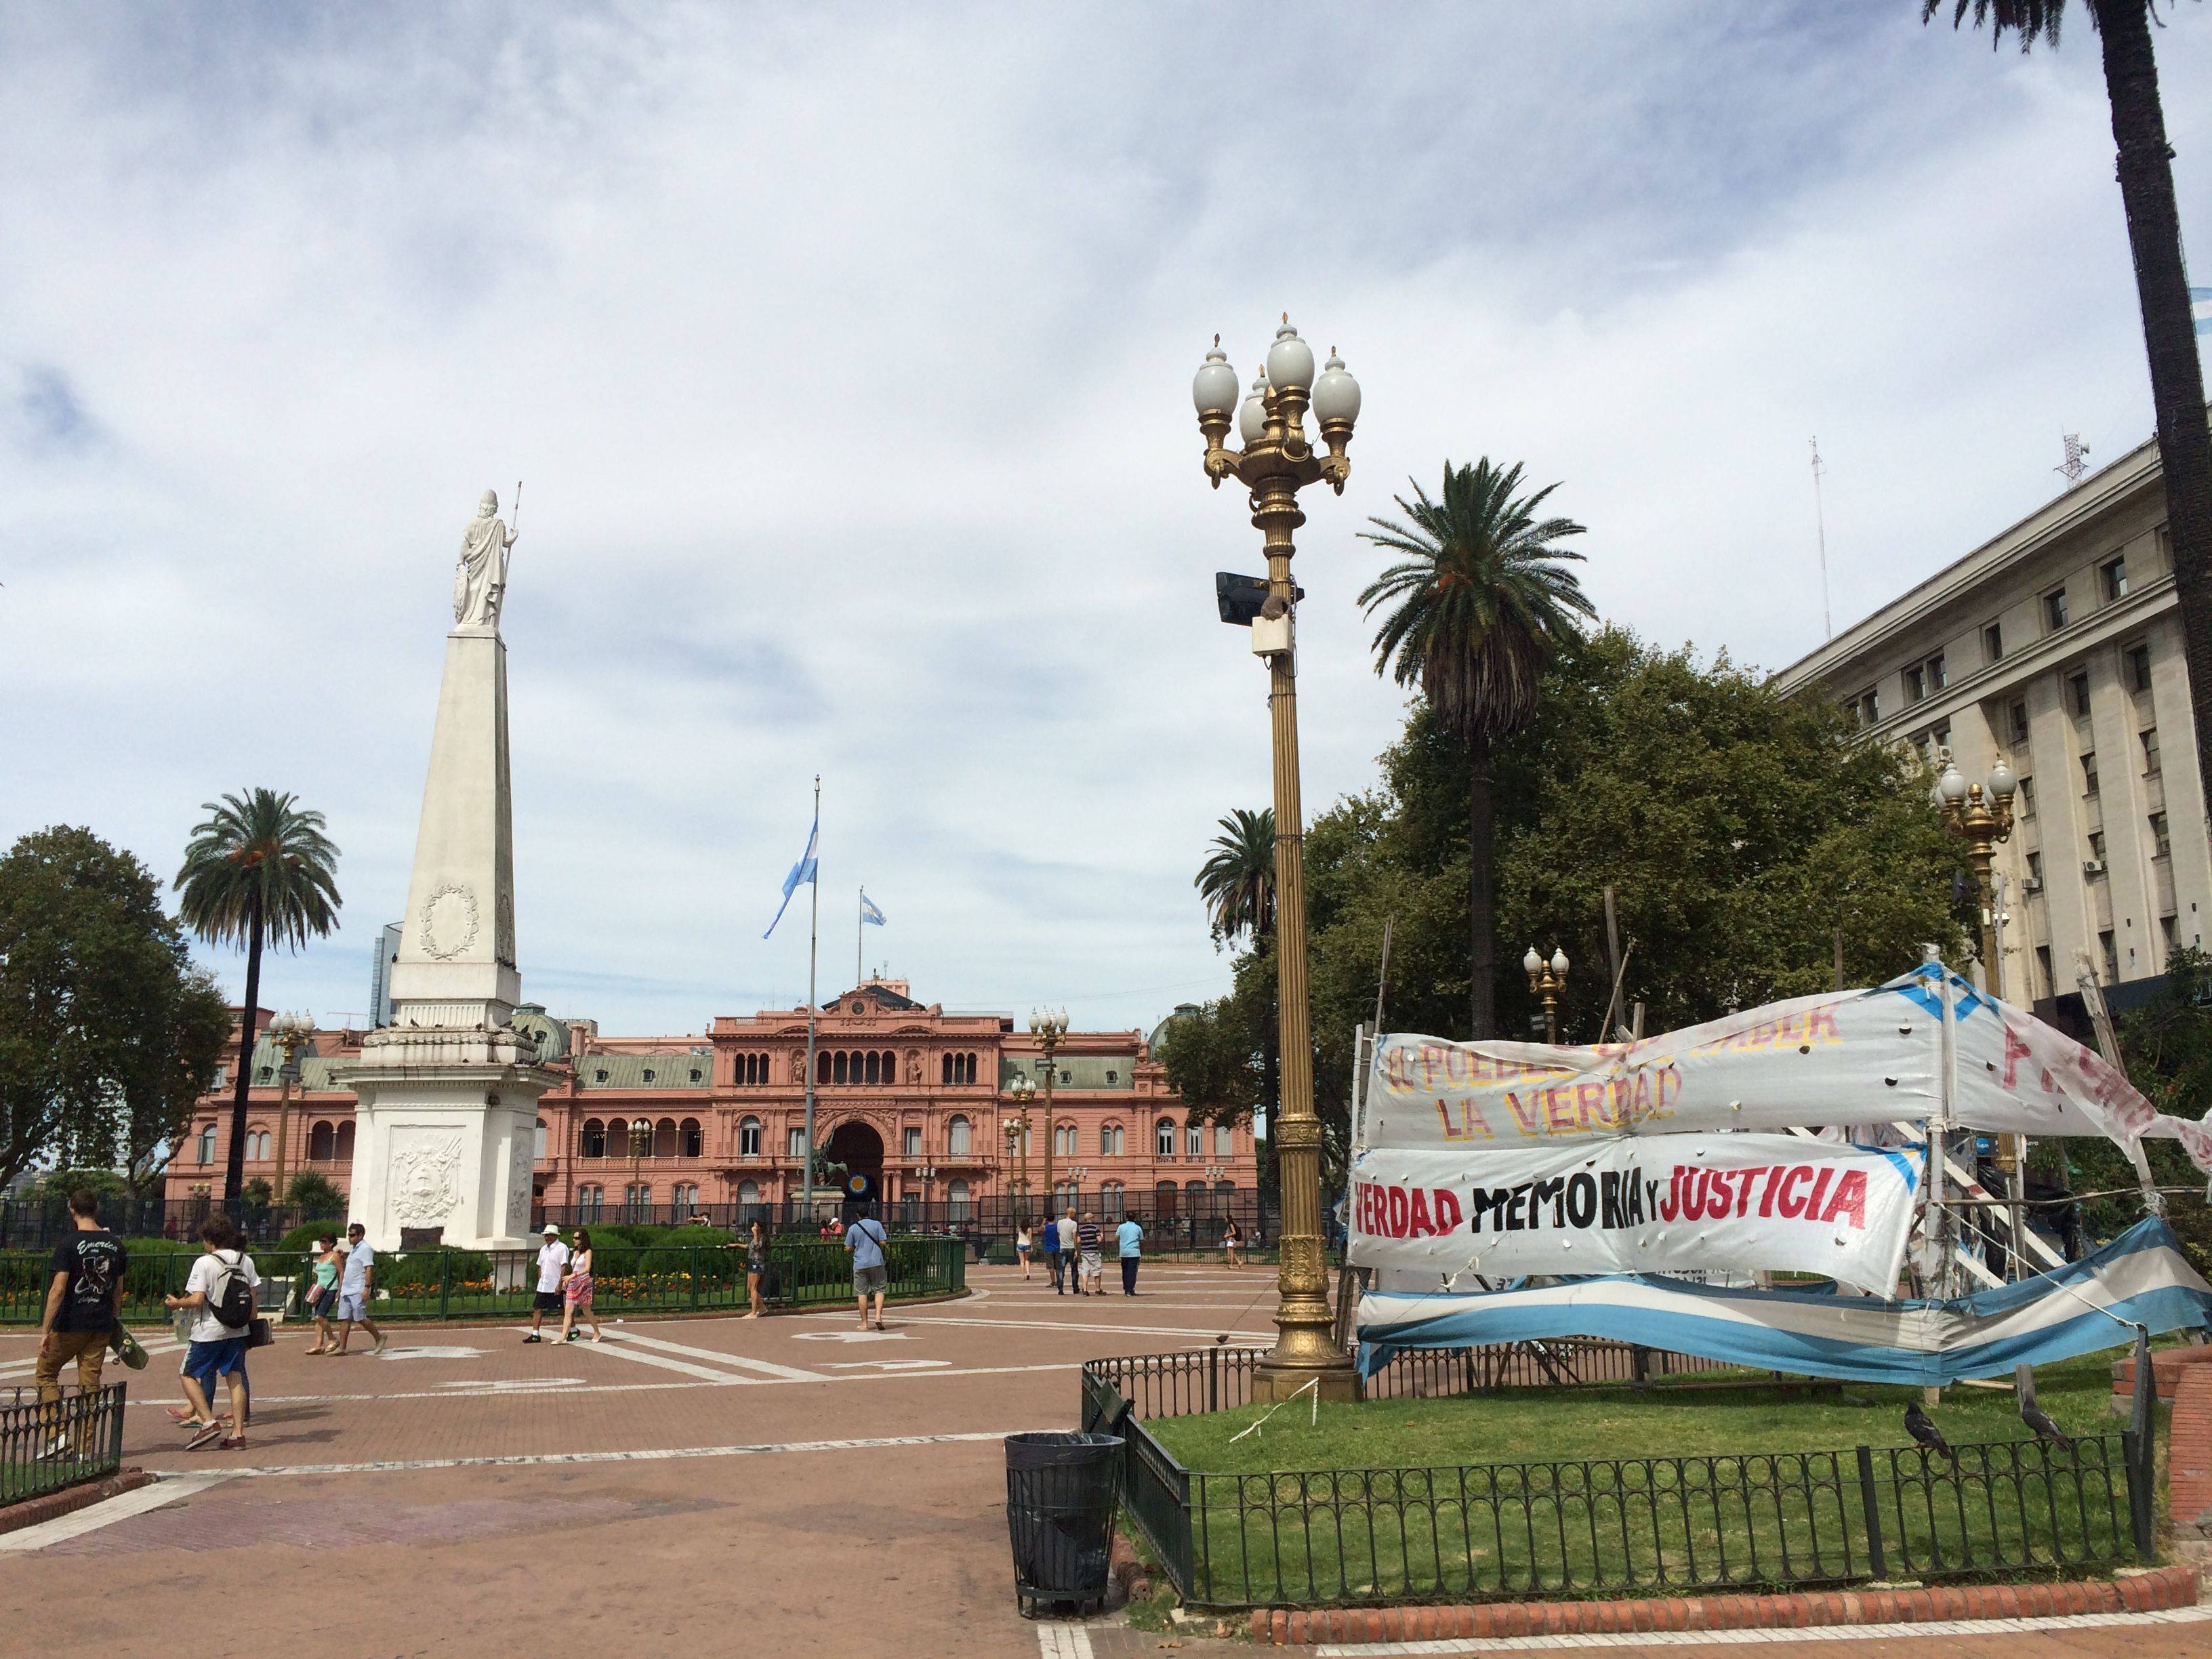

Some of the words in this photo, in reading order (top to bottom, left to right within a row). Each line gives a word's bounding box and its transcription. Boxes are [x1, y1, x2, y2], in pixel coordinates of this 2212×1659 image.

[1435, 1098, 1494, 1140] LA
[1505, 1065, 1682, 1136] VERDAD
[1355, 1182, 1463, 1239] VERDAD
[1471, 1166, 1645, 1233] MEMORIA
[1645, 1179, 1659, 1221] Y
[1660, 1165, 1868, 1230] JUSTICIA
[77, 1240, 119, 1255] Emerica
